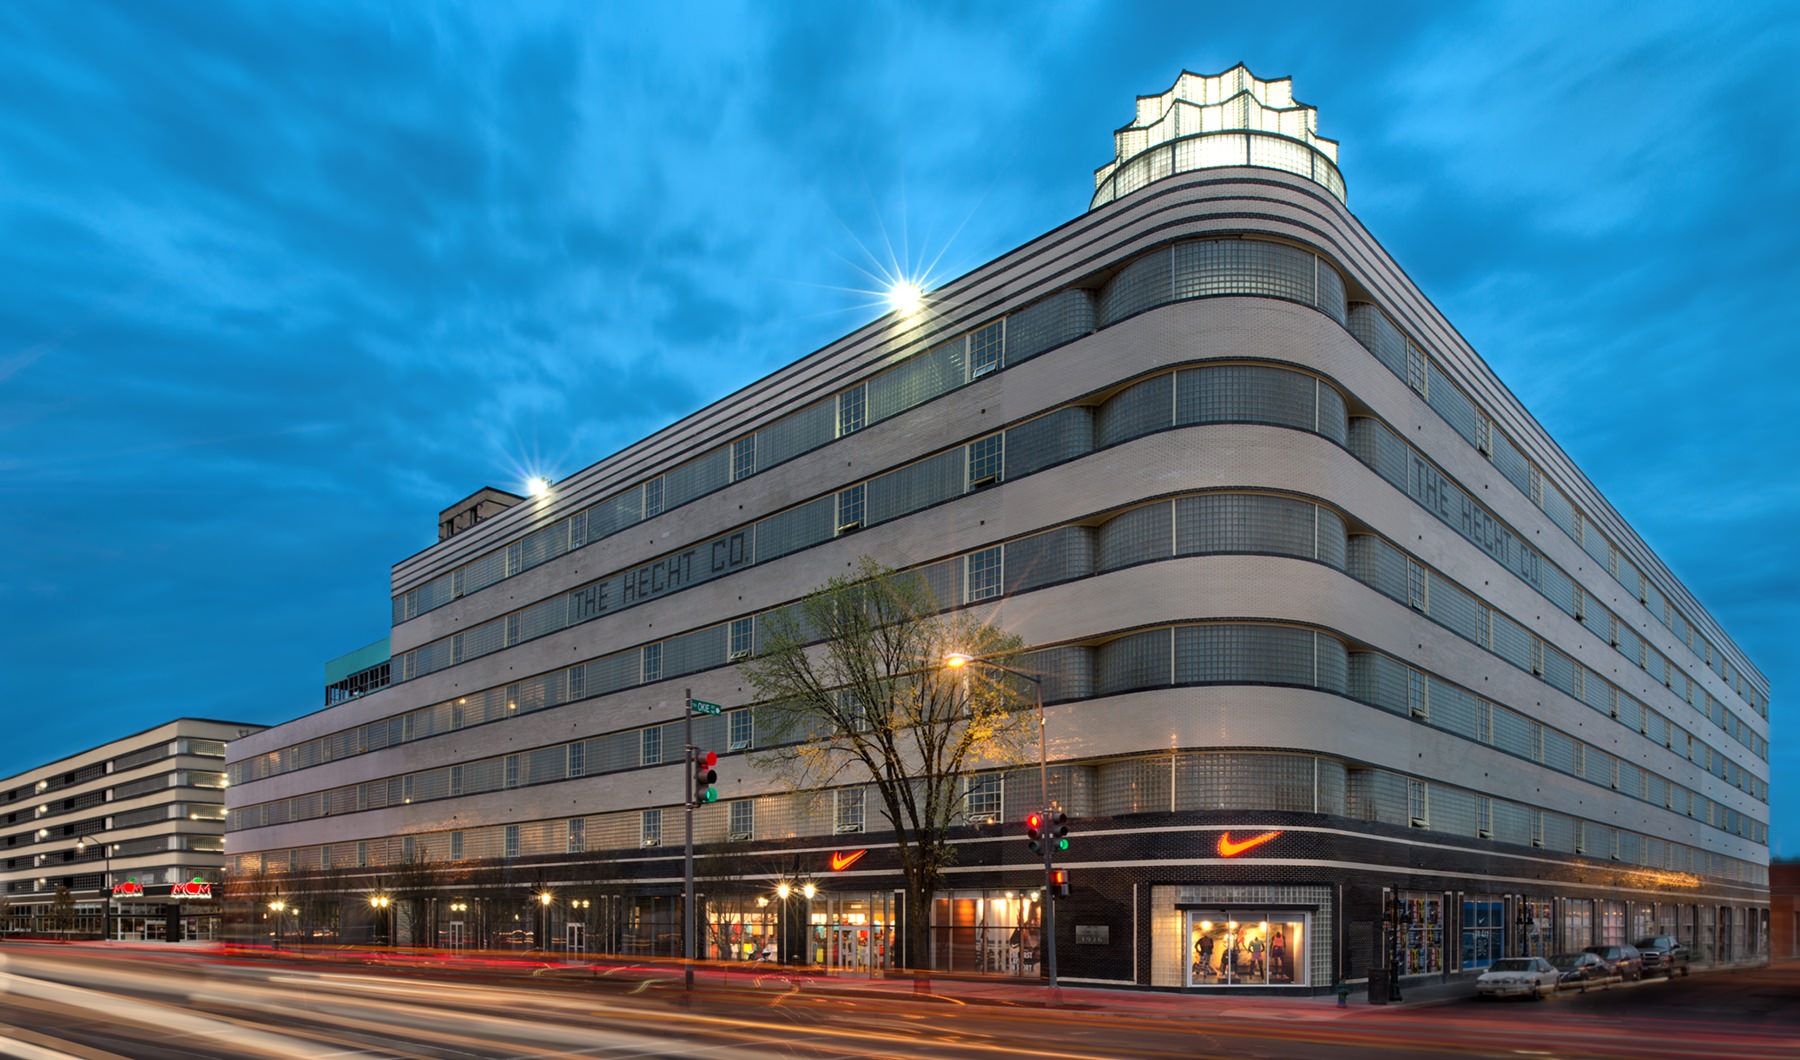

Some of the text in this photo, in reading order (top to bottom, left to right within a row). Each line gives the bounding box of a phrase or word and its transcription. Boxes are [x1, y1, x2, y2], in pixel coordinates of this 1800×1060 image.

[1413, 456, 1449, 519] THE
[1461, 496, 1511, 564] HECHT
[574, 532, 750, 619] THE HECHT CO.
[698, 702, 710, 713] OKIE
[171, 882, 213, 895] MOM
